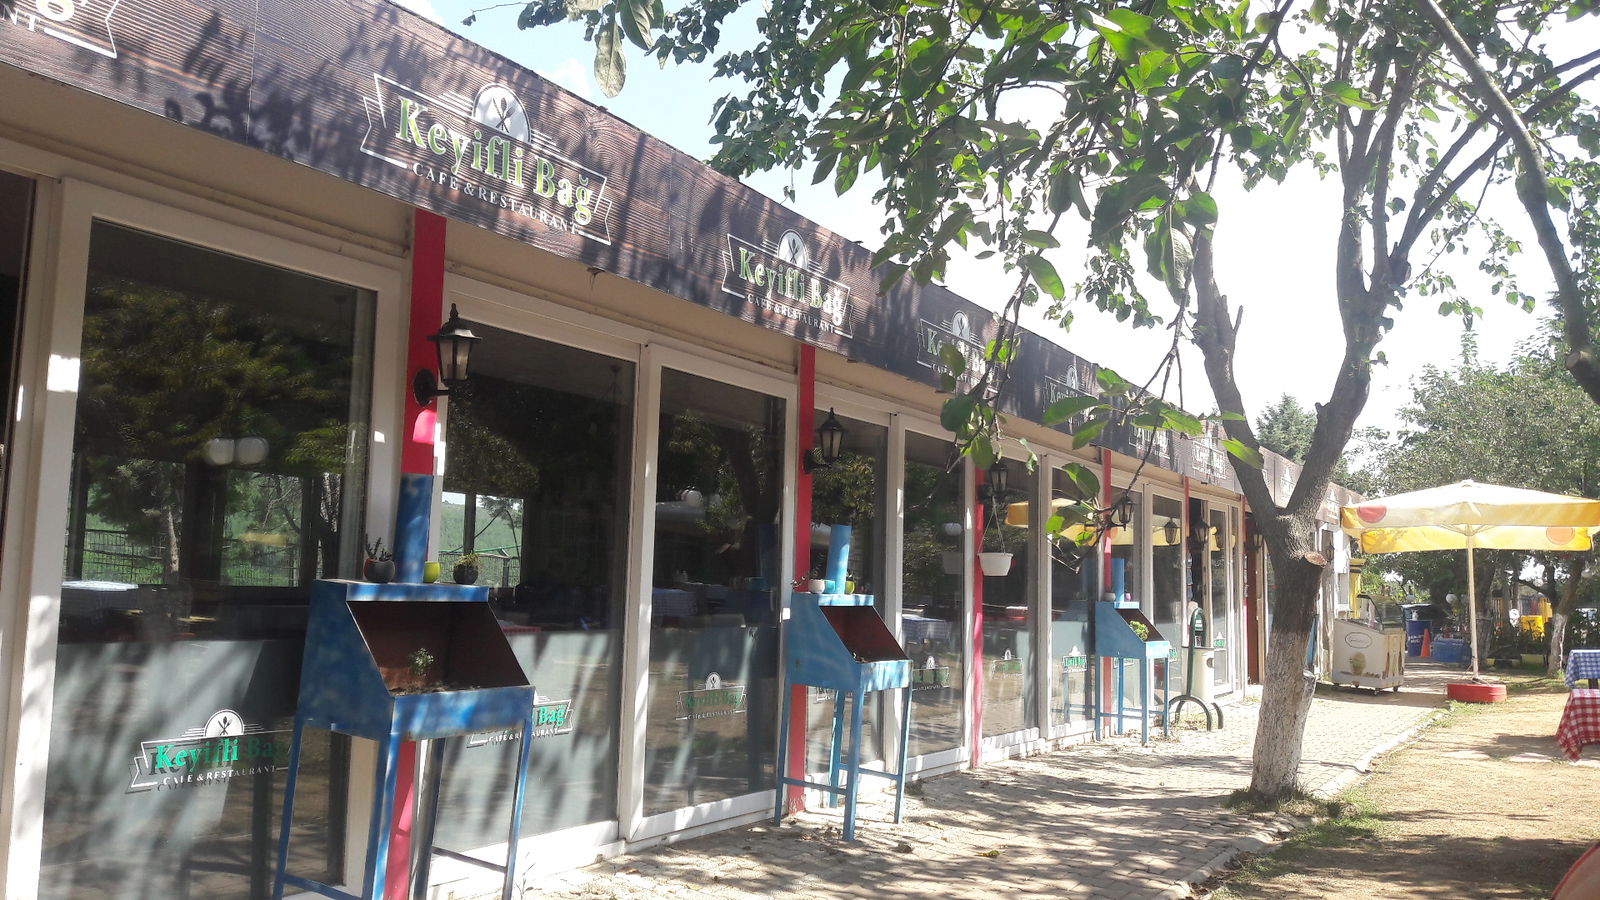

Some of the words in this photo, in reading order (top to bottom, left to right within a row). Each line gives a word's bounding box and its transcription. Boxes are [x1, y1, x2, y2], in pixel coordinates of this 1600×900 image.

[396, 96, 525, 188] Keyifli
[533, 155, 593, 225] Bağ
[412, 162, 460, 190] CAFE
[478, 187, 582, 235] RESTAURANT
[739, 247, 806, 303] Keyifli
[155, 738, 239, 771] Keyifli
